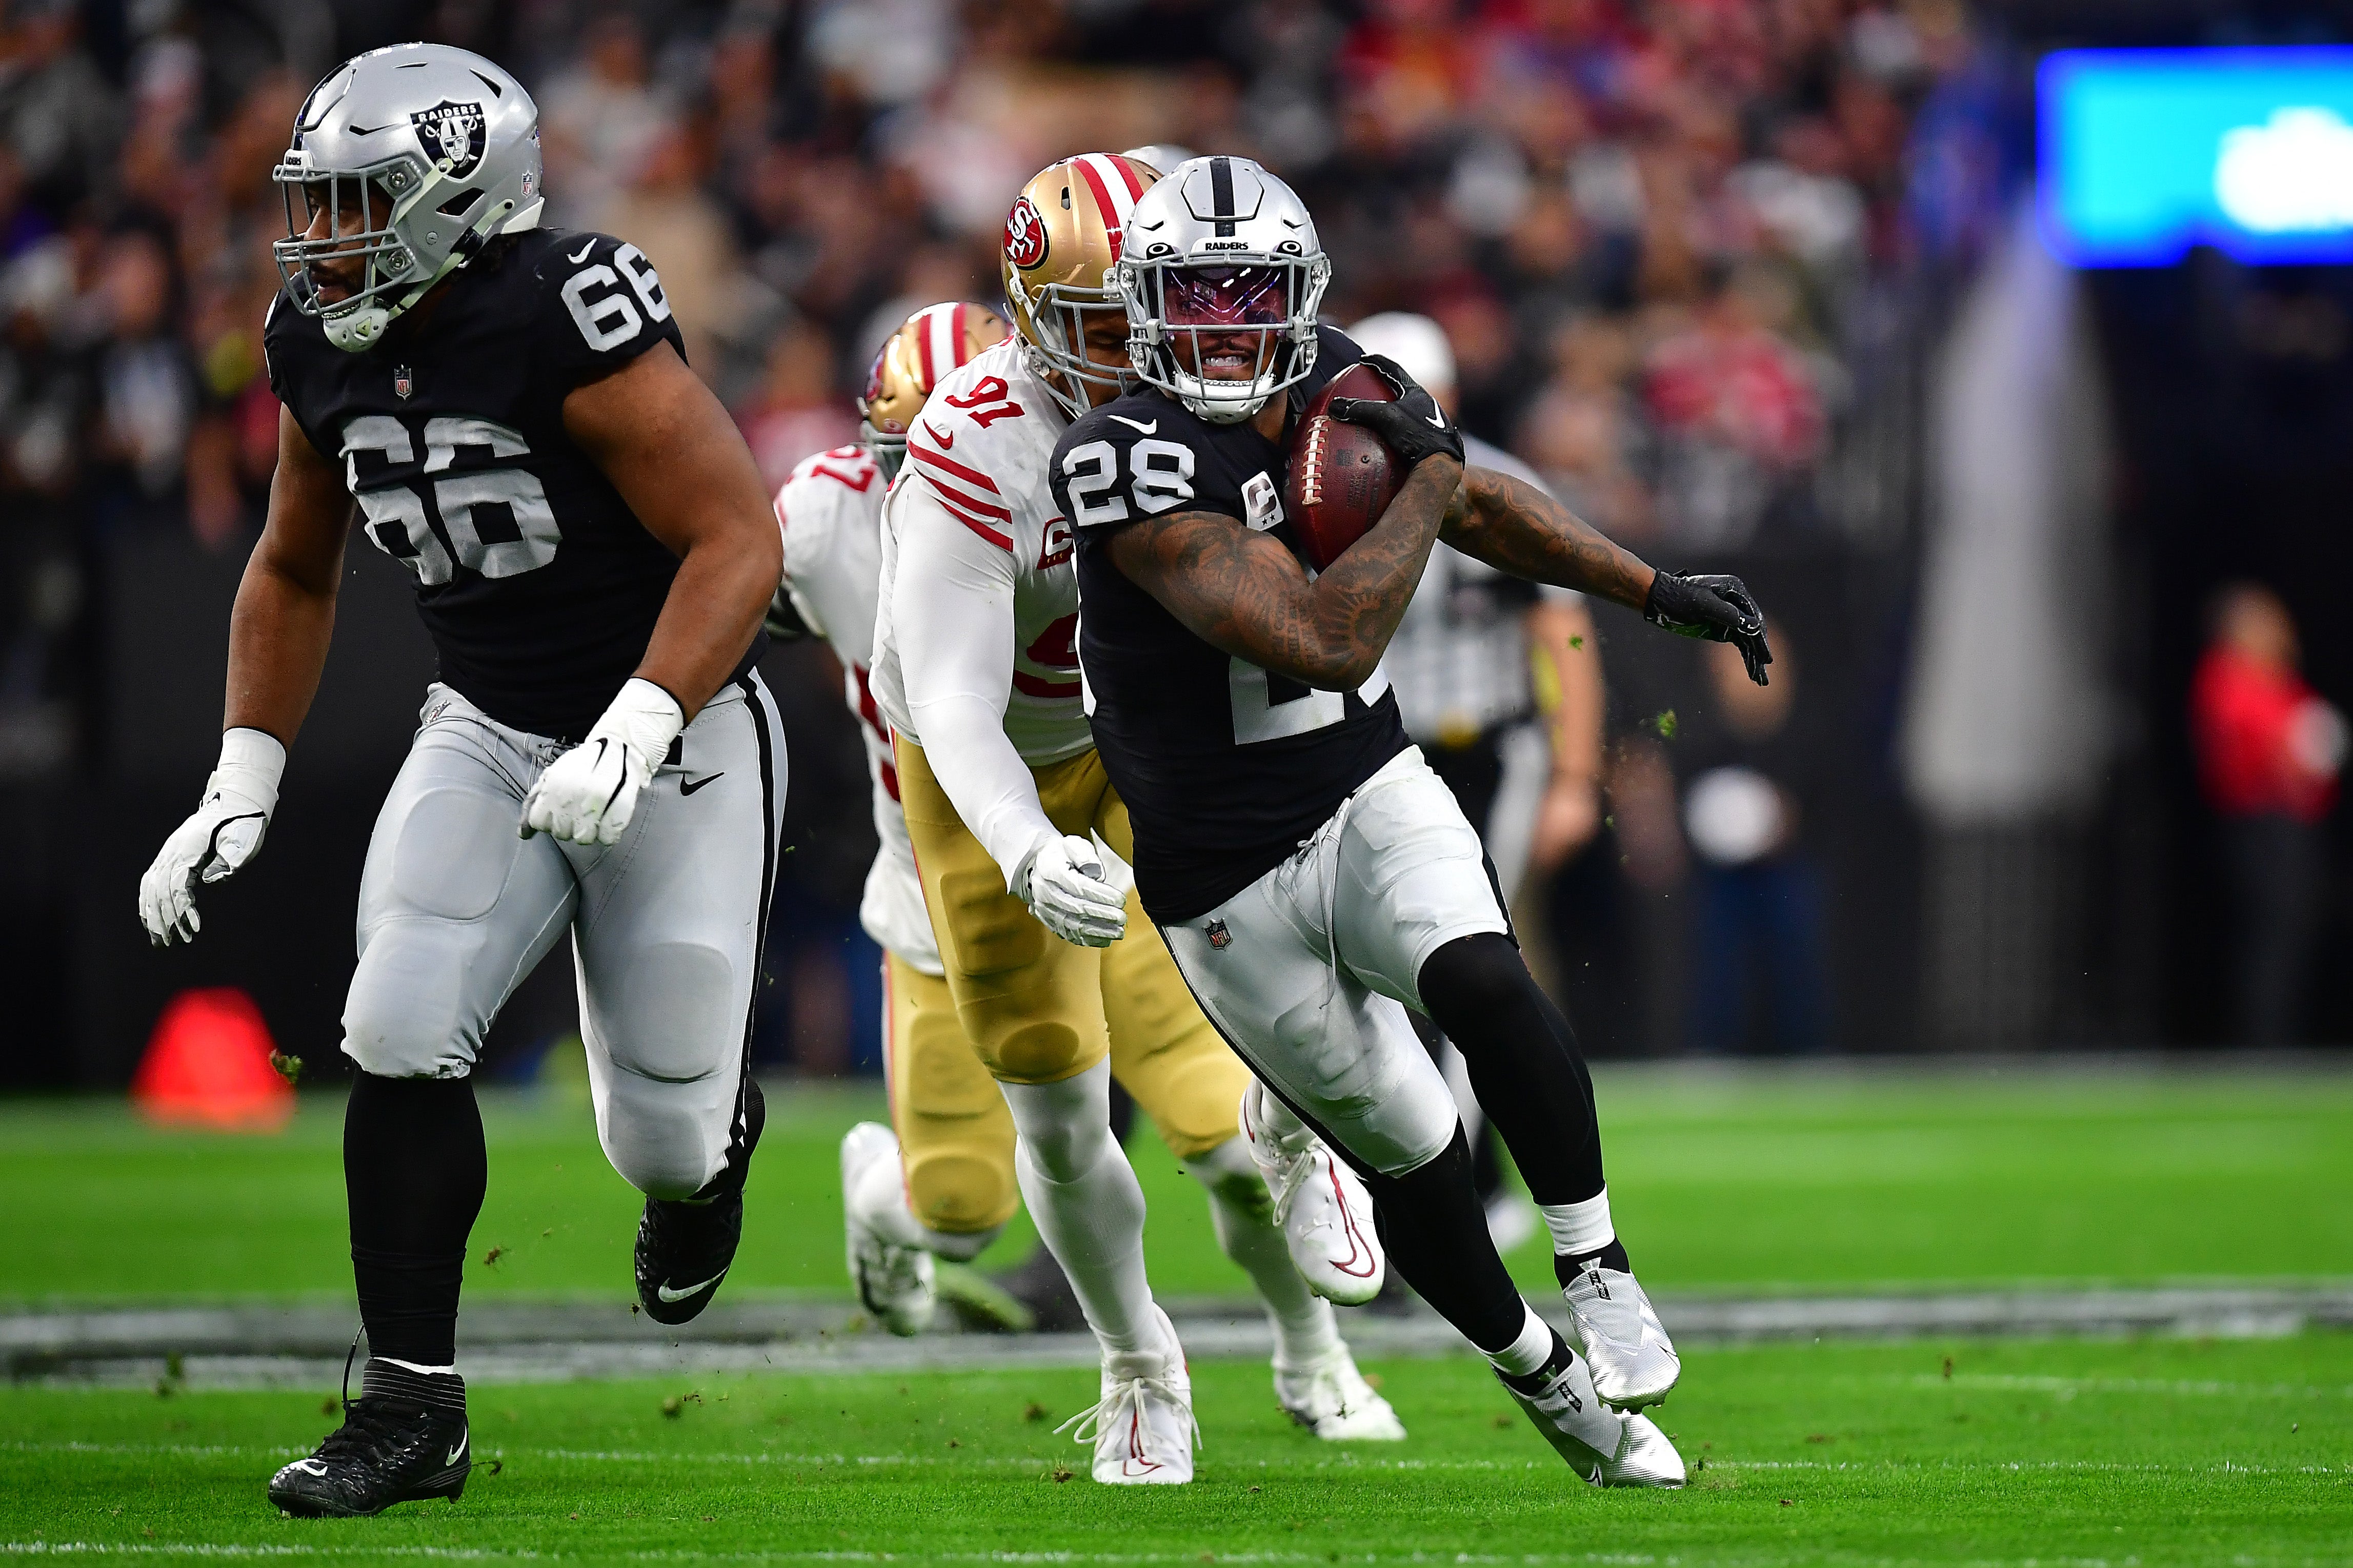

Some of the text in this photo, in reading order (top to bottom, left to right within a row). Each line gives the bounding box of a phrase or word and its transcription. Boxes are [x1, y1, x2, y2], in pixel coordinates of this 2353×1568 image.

[418, 105, 477, 123] RAIDERS
[1205, 241, 1249, 251] RAIDERS
[560, 242, 672, 352] 66
[944, 375, 1025, 429] 91
[338, 415, 563, 586] 66
[1062, 438, 1195, 527] 28
[1248, 478, 1277, 519] C
[1045, 521, 1073, 557] C
[1211, 929, 1230, 945] NFL
